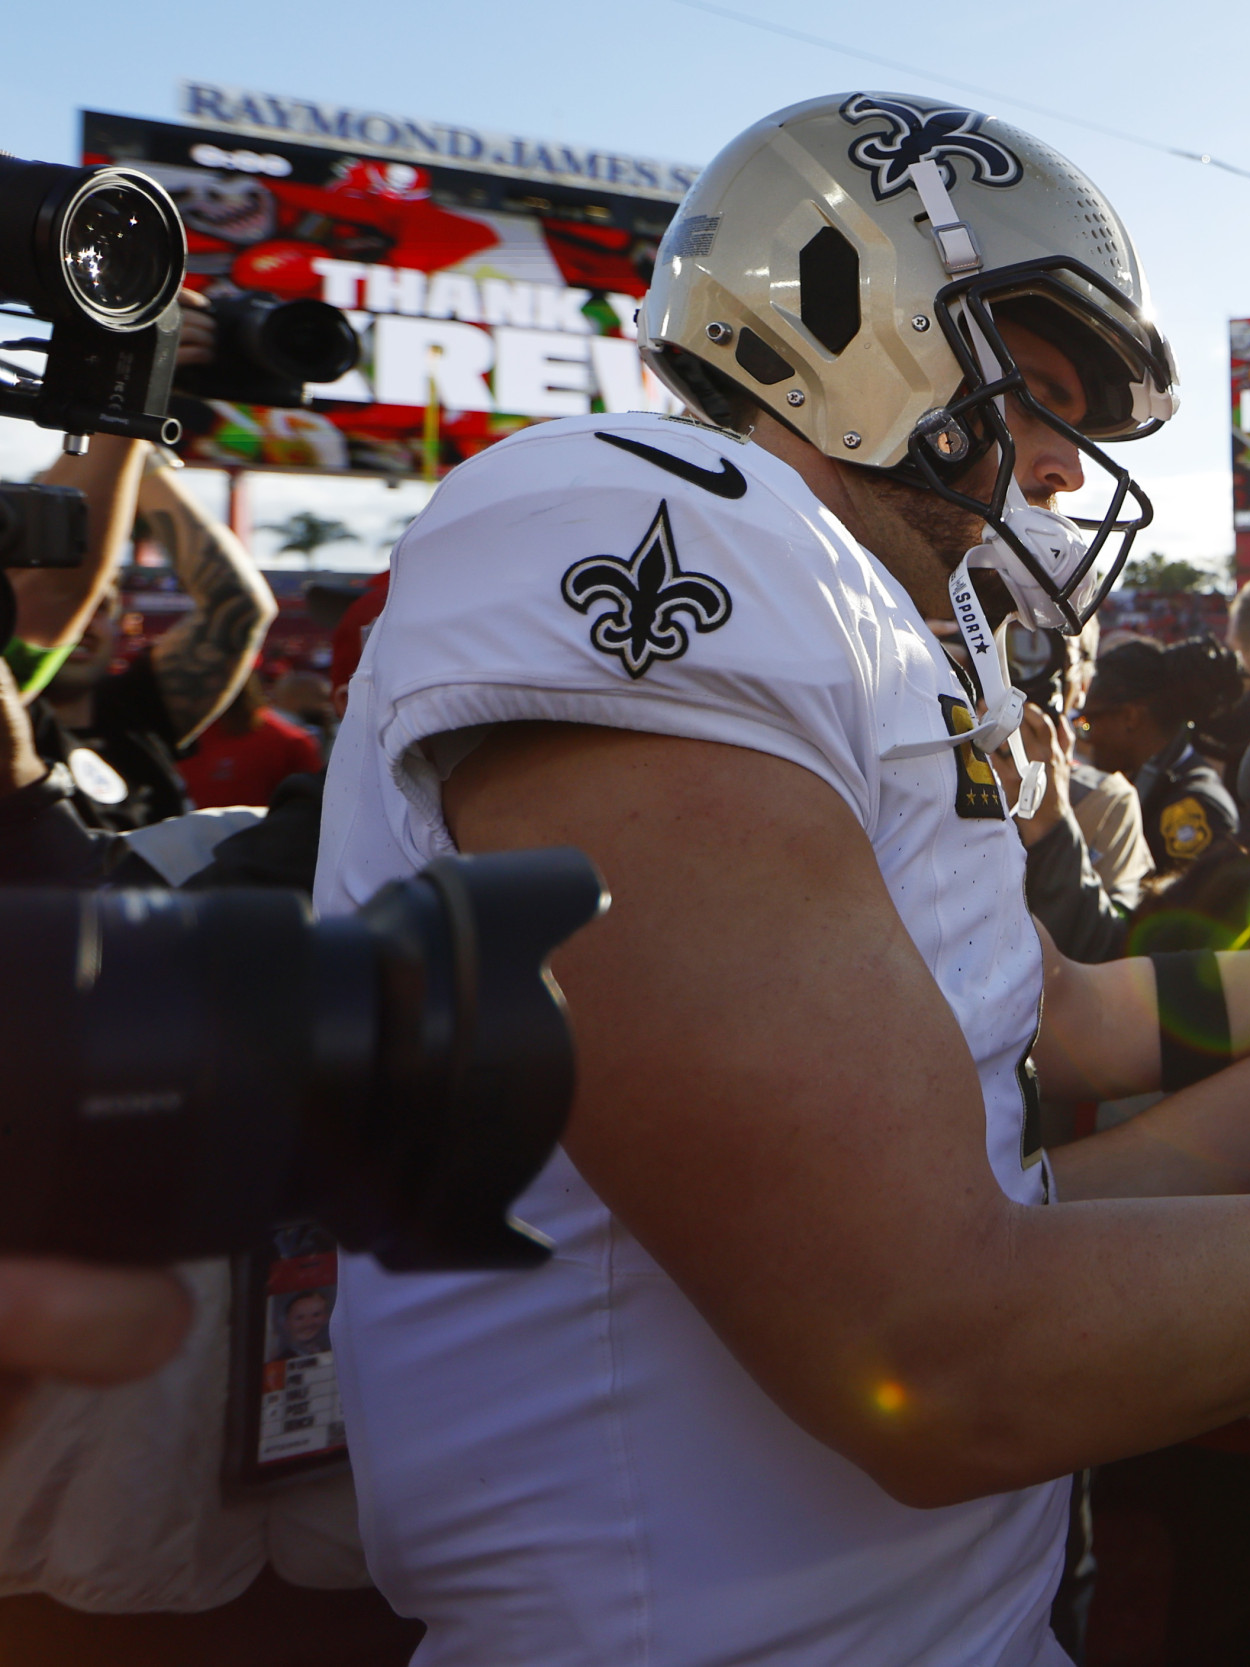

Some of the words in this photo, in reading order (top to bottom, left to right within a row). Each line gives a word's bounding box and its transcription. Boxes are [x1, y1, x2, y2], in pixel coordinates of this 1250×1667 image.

[184, 83, 485, 160] RAYMOND
[493, 135, 660, 187] JAMES
[311, 257, 593, 334] THANK
[303, 312, 692, 418] REW
[955, 591, 985, 641] SPORT
